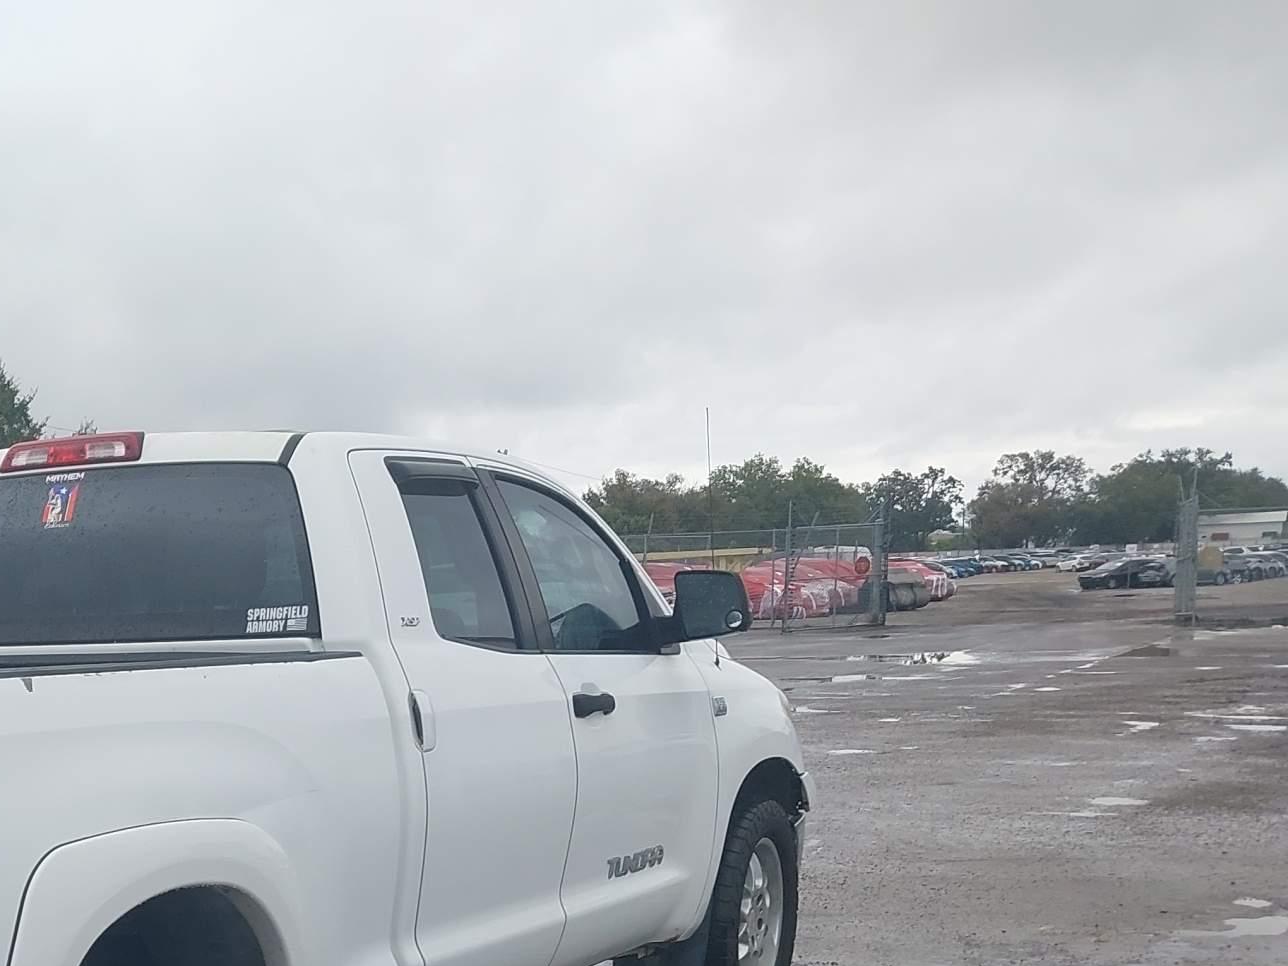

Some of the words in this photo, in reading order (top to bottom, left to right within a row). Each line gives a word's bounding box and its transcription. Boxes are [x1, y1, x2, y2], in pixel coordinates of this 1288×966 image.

[247, 605, 309, 621] SPRINGFIELD
[246, 620, 285, 633] ARMORY
[607, 845, 664, 880] TUNDRA
